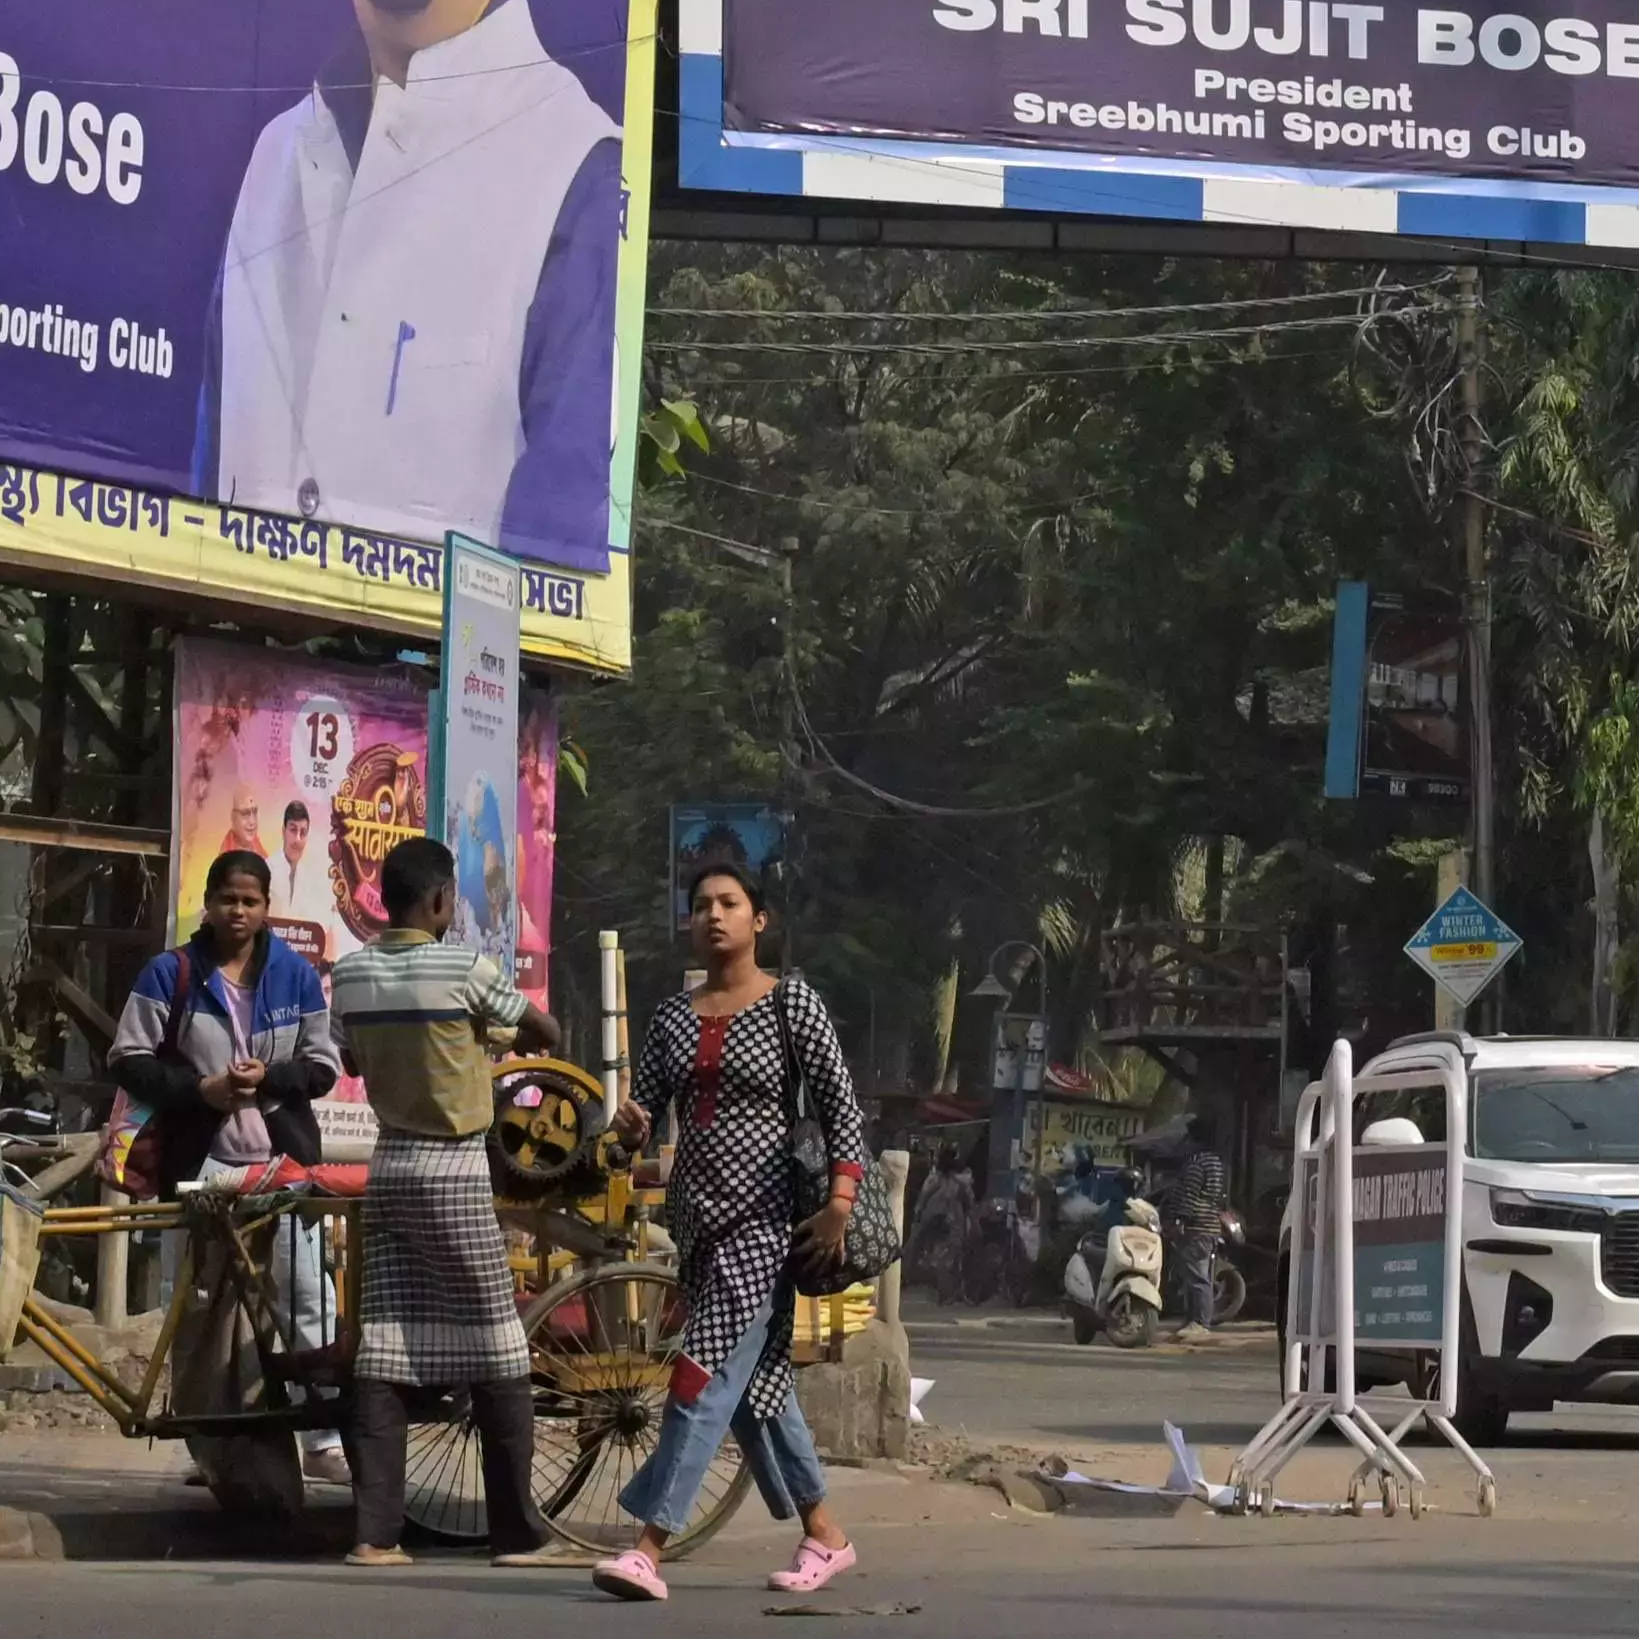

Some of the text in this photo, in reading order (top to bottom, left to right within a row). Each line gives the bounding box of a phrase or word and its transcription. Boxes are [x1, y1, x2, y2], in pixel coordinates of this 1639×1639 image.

[1193, 69, 1413, 115] President
[1012, 92, 1586, 162] Sreebhumi Sporting Club
[108, 315, 175, 380] Club
[305, 711, 339, 761] 13
[1416, 1167, 1445, 1216] POLICE
